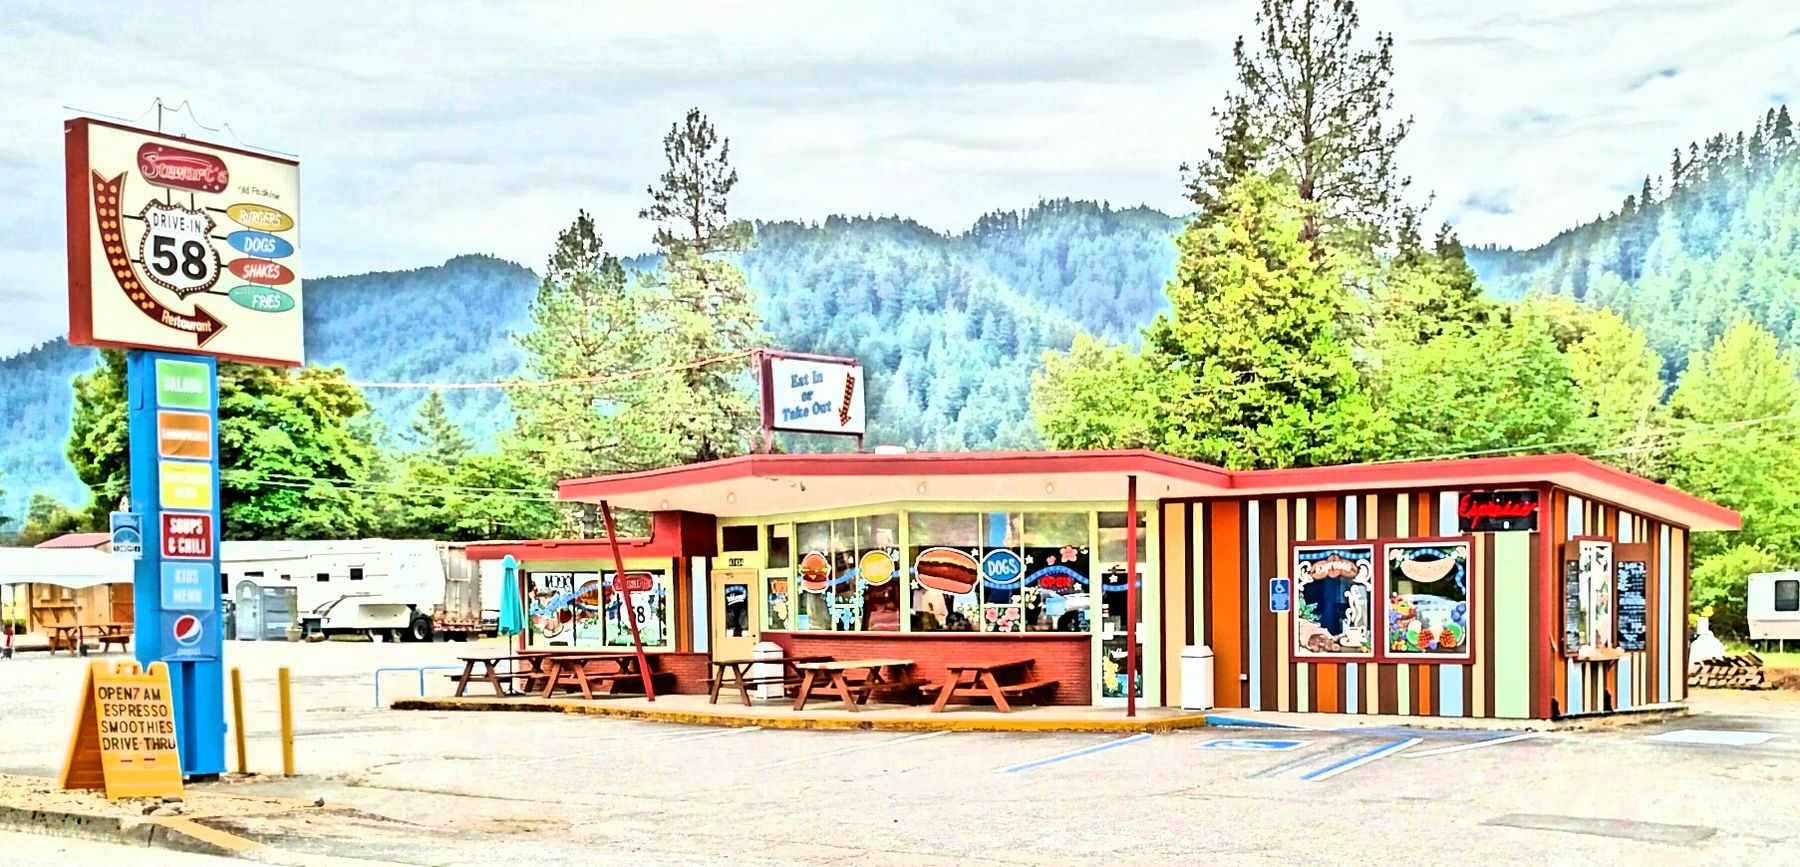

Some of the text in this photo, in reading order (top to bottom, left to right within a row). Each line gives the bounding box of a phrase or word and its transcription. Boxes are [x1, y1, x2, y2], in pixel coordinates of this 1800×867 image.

[142, 152, 228, 184] Stewart's
[153, 212, 202, 233] DRIVE-IN
[240, 209, 282, 227] BURGERS
[244, 237, 276, 253] DOGS
[152, 235, 207, 280] 58
[242, 264, 280, 279] SHAKES
[252, 294, 281, 309] FRIES
[161, 309, 213, 332] Restaurant
[791, 370, 823, 388] Eat In
[801, 390, 814, 402] or
[782, 400, 832, 422] Take Out
[1459, 494, 1537, 529] Espresso
[170, 517, 203, 535] SOUPS
[168, 537, 206, 554] & CHILI
[987, 557, 1018, 577] DOGS
[175, 568, 200, 584] KIDS
[1040, 575, 1072, 589] OPEN
[173, 588, 203, 604] MENU
[143, 688, 161, 701] AM
[103, 703, 168, 718] ESPRESSO
[101, 720, 174, 734] SMOOTHIES
